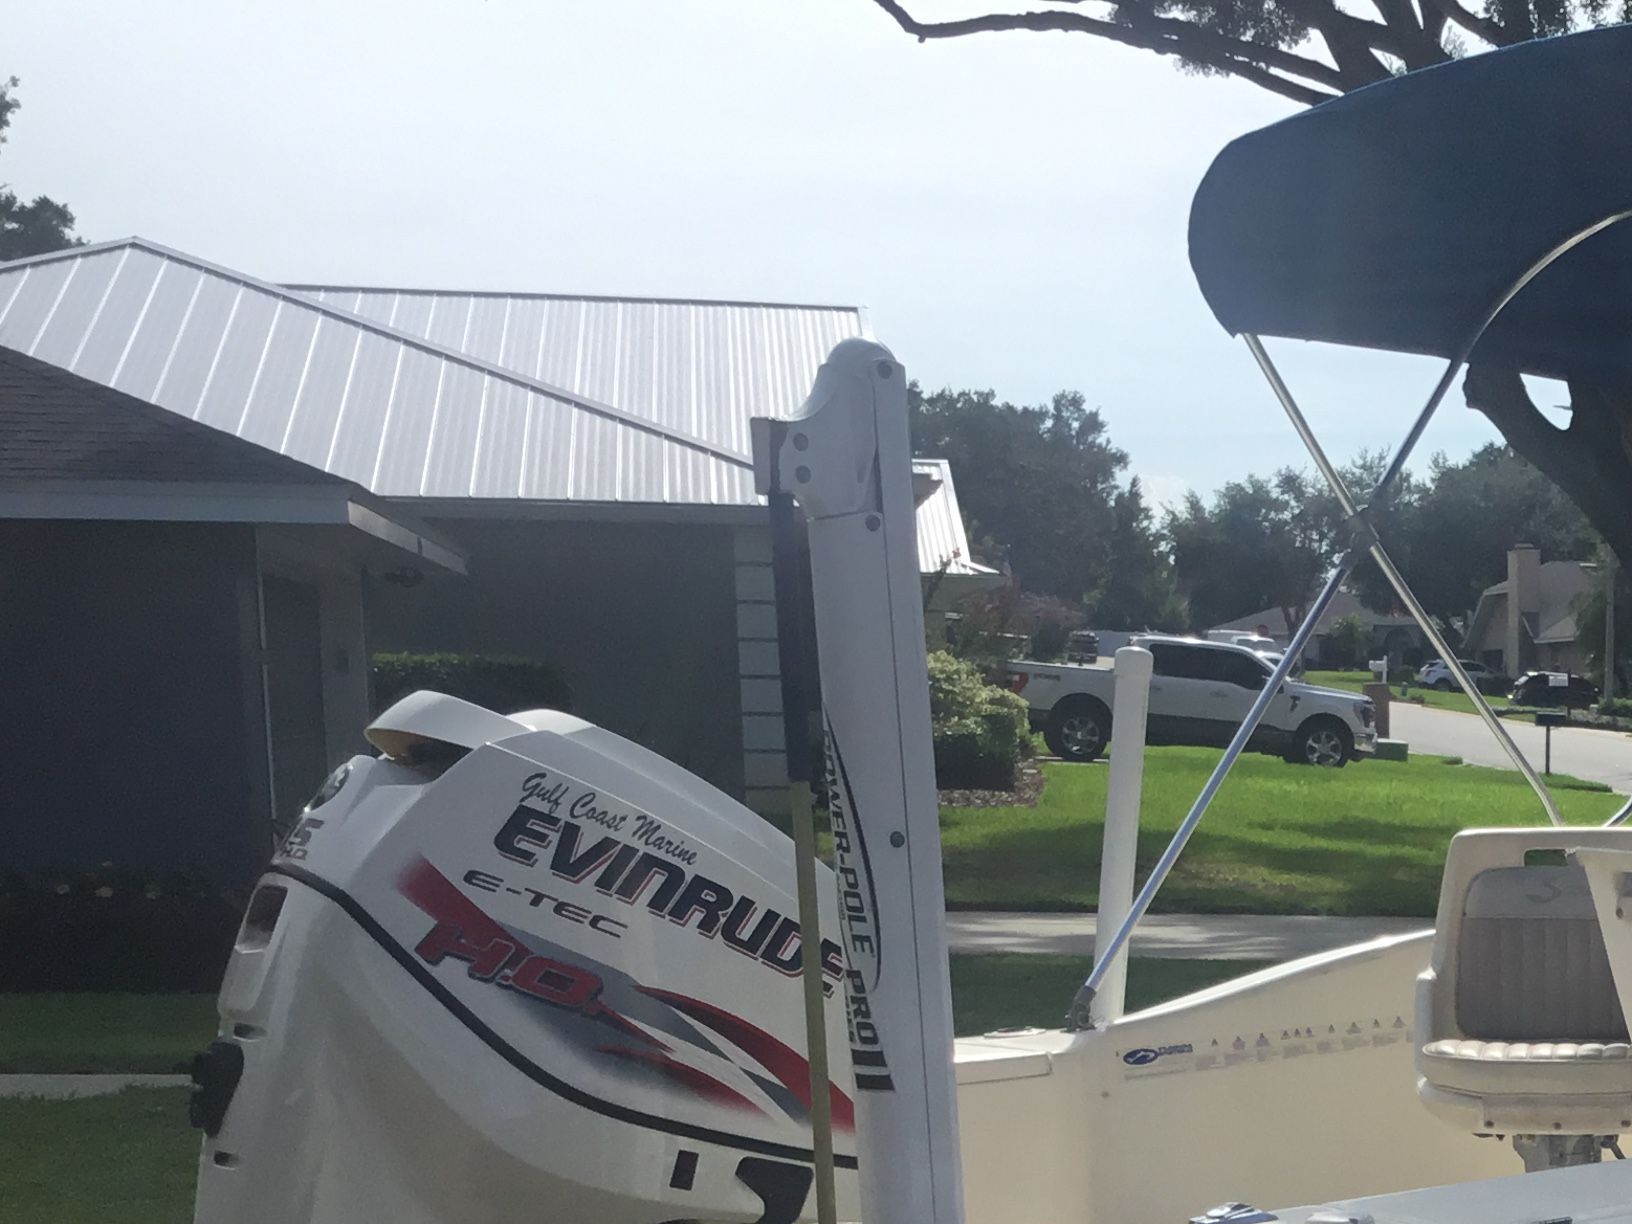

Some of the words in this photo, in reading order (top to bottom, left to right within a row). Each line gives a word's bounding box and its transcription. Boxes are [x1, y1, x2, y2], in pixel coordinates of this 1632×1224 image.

[521, 772, 570, 814] Gulf
[569, 791, 629, 832] Coast
[631, 811, 698, 866] Marine
[463, 869, 629, 938] E-TEC
[846, 969, 880, 1046] PRO
